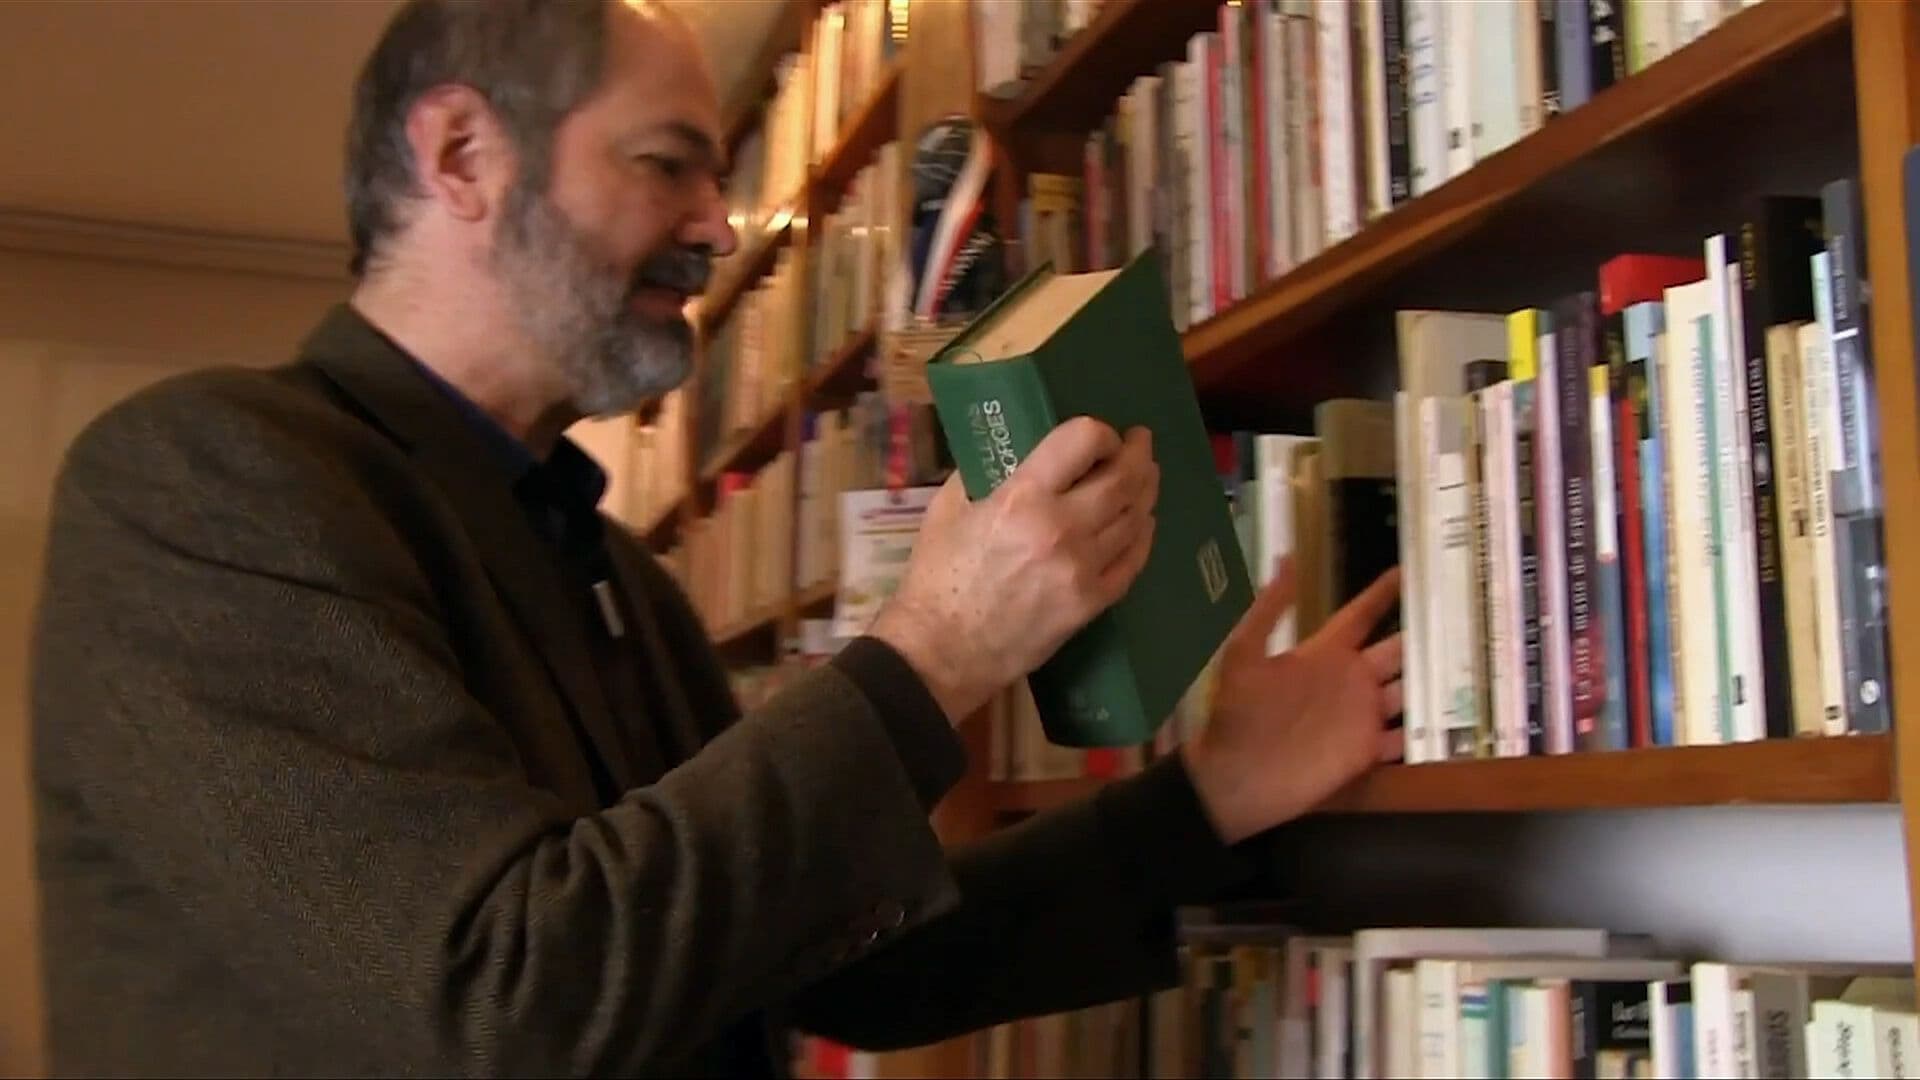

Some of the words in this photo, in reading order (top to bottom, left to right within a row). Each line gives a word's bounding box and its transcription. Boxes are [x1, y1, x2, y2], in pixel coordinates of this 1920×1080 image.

[1567, 477, 1586, 549] Lepanto
[1569, 554, 1585, 575] de
[1572, 581, 1589, 631] mano
[1574, 638, 1591, 674] otra
[1574, 680, 1591, 702] La
